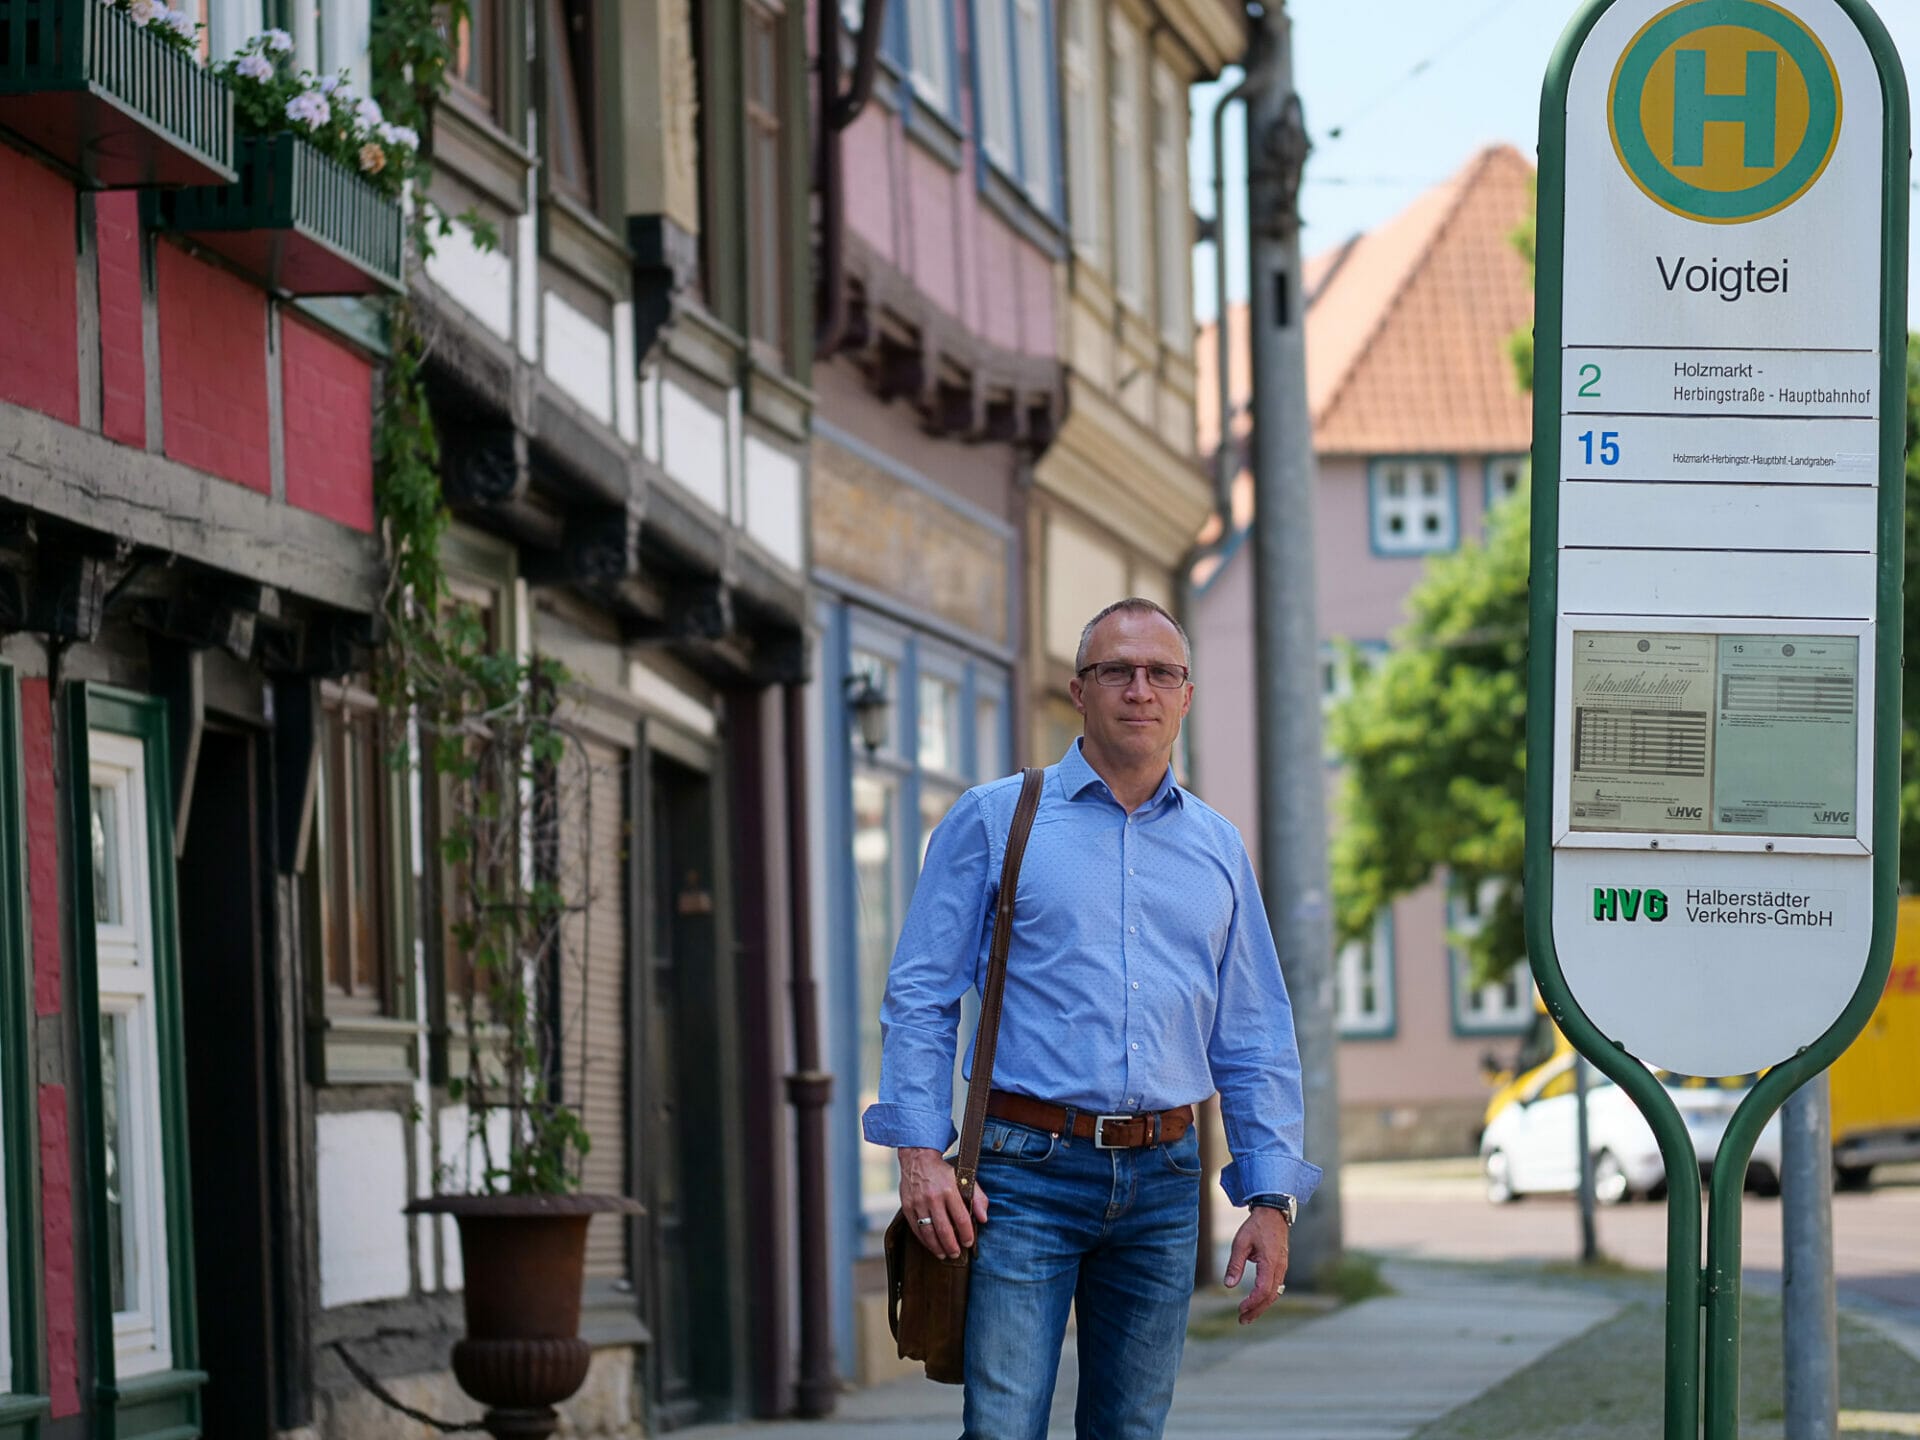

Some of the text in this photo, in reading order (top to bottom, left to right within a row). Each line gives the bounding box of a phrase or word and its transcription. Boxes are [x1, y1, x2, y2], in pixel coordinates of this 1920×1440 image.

[1672, 49, 1777, 168] H
[1655, 255, 1789, 302] Voigtei
[1673, 361, 1753, 378] Holzmarkt
[1577, 363, 1602, 398] 2
[1673, 386, 1765, 404] Herbingstraße
[1778, 387, 1871, 405] Hauptbahnhof
[1578, 430, 1621, 466] 15
[1588, 640, 1594, 648] 2
[1733, 645, 1744, 653] 15
[1675, 806, 1703, 818] HVG
[1822, 811, 1850, 823] HVG
[1593, 887, 1668, 922] HVG
[1686, 888, 1811, 908] Halberstädter
[1685, 906, 1833, 927] Verkehrs-GmbH
